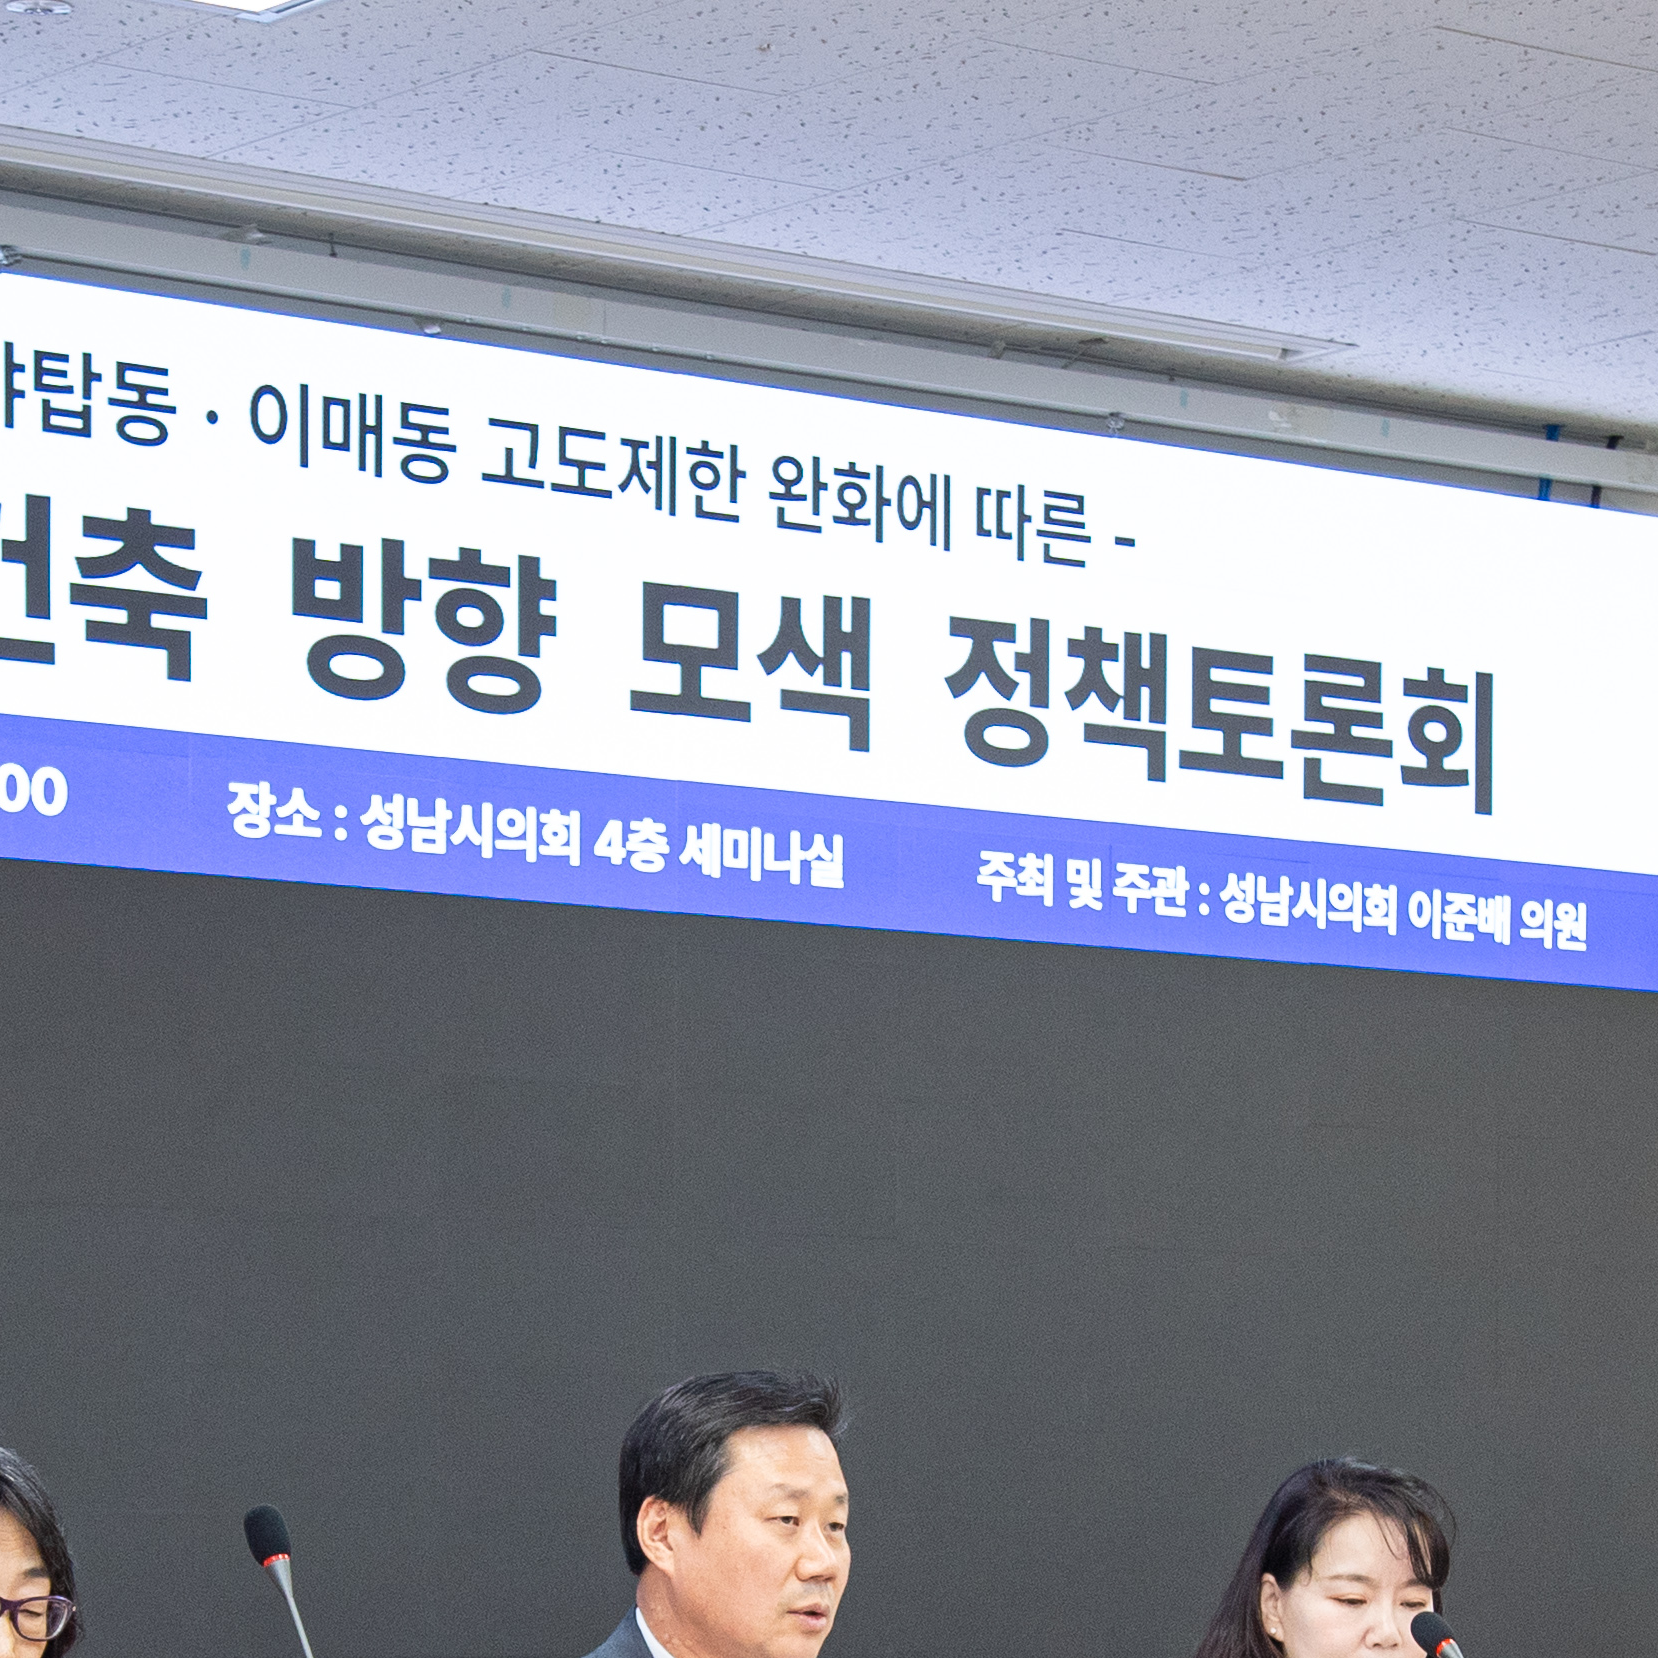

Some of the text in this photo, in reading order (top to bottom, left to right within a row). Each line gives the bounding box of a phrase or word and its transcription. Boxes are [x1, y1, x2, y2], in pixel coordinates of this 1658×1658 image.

[249, 383, 458, 485] 이매동
[481, 417, 747, 524] 고도제한
[768, 455, 951, 552] 완화에
[975, 483, 1092, 569] 따른
[291, 536, 558, 716] 방향
[629, 581, 871, 753] 모색
[943, 615, 1494, 816] 정책토론회
[226, 780, 323, 839] 장소
[359, 793, 581, 867] 성남시의회
[593, 817, 671, 873] 4층
[678, 822, 845, 889] 세미나실
[976, 850, 1054, 908] 주최
[1066, 857, 1103, 911] 및
[1112, 862, 1191, 918] 주관
[1219, 872, 1398, 936] 성남시의회
[1408, 888, 1512, 946] 이준배
[1519, 898, 1587, 952] 의원
